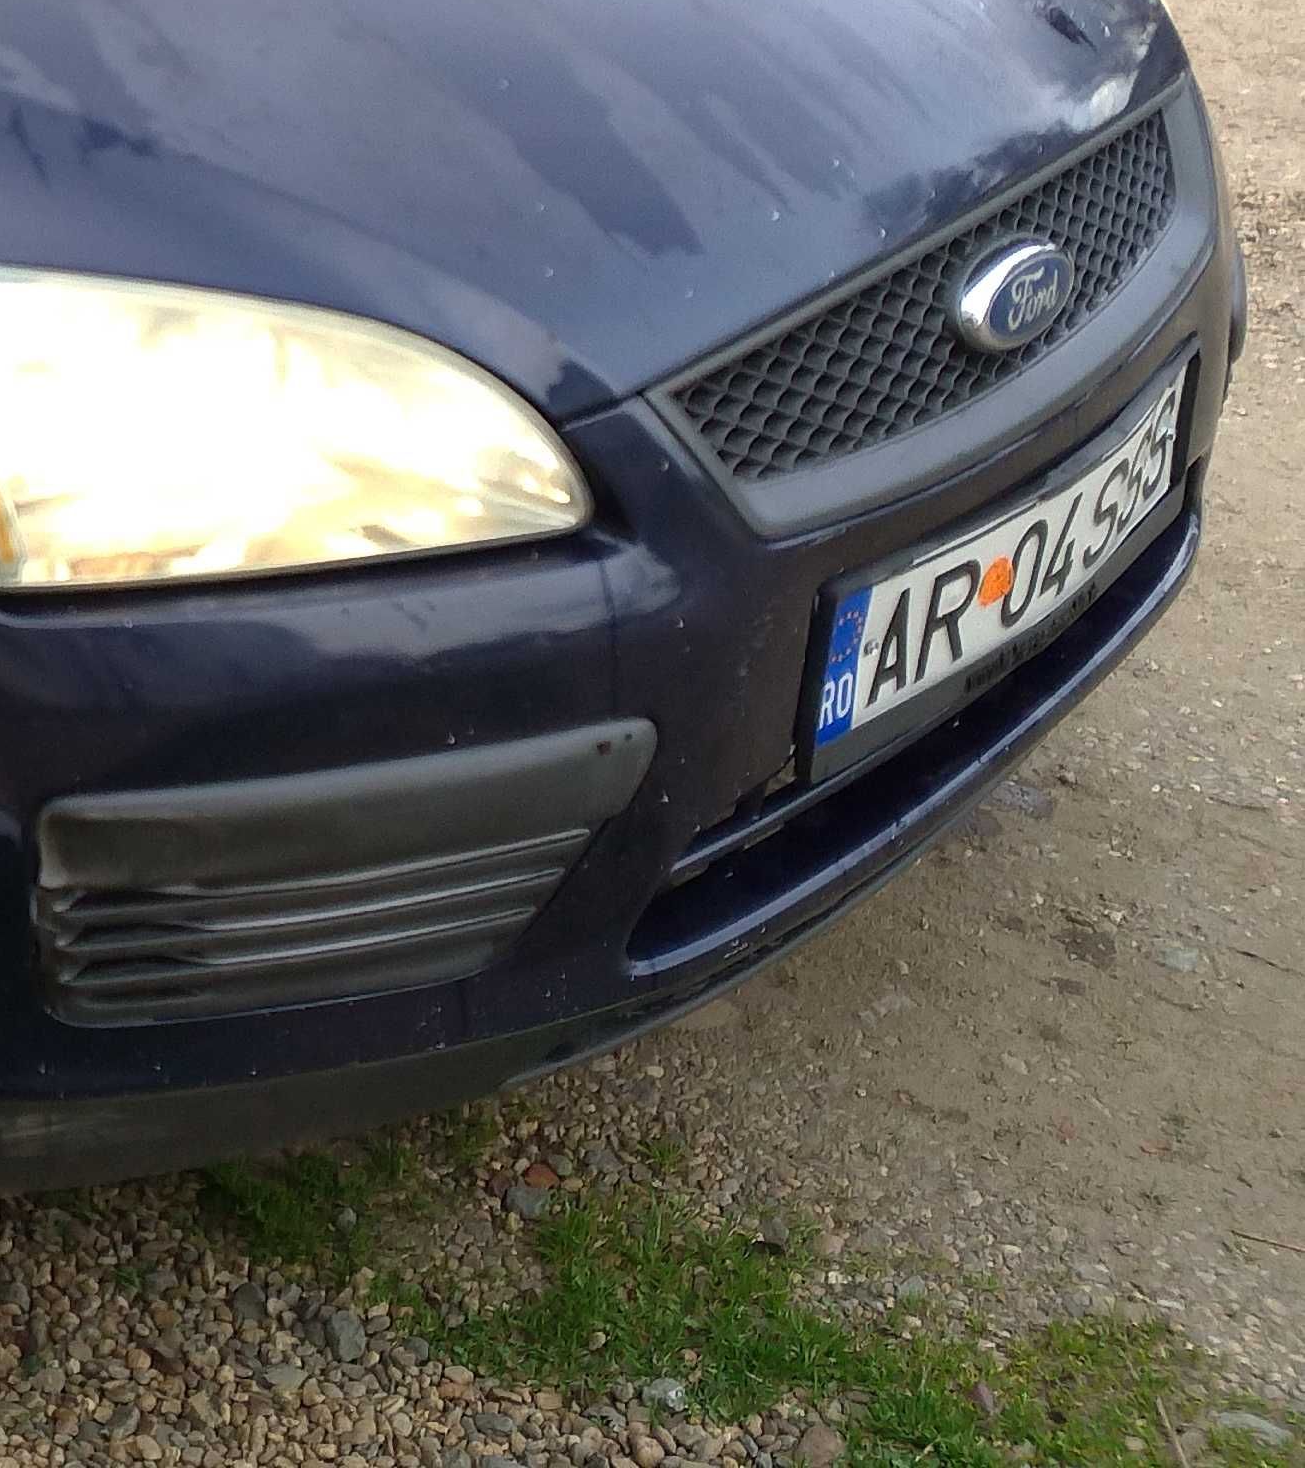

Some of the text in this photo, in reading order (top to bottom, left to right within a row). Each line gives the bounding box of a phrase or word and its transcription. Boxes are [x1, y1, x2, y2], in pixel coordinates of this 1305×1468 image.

[1008, 266, 1058, 330] Ford
[865, 558, 981, 708] AR
[1000, 491, 1083, 627] 04
[819, 671, 854, 730] RO
